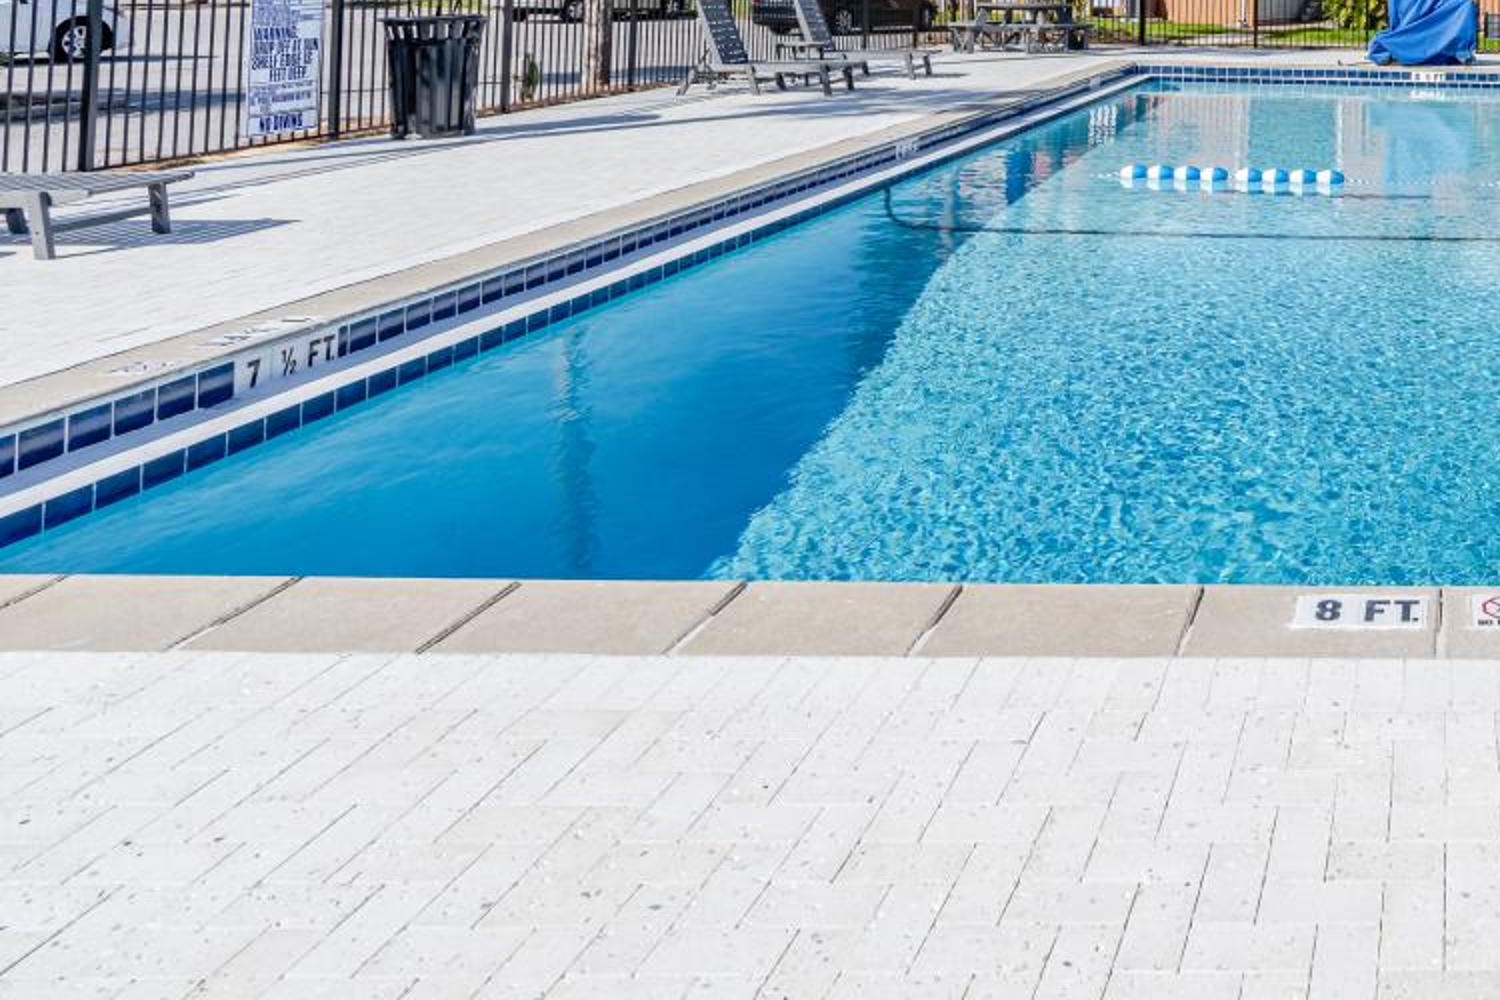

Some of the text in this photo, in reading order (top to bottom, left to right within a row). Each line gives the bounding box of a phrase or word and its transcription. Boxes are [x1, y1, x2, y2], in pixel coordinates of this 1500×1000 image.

[260, 112, 303, 133] NO DIVING
[247, 359, 261, 389] 7
[1315, 599, 1420, 623] 8 FT.
